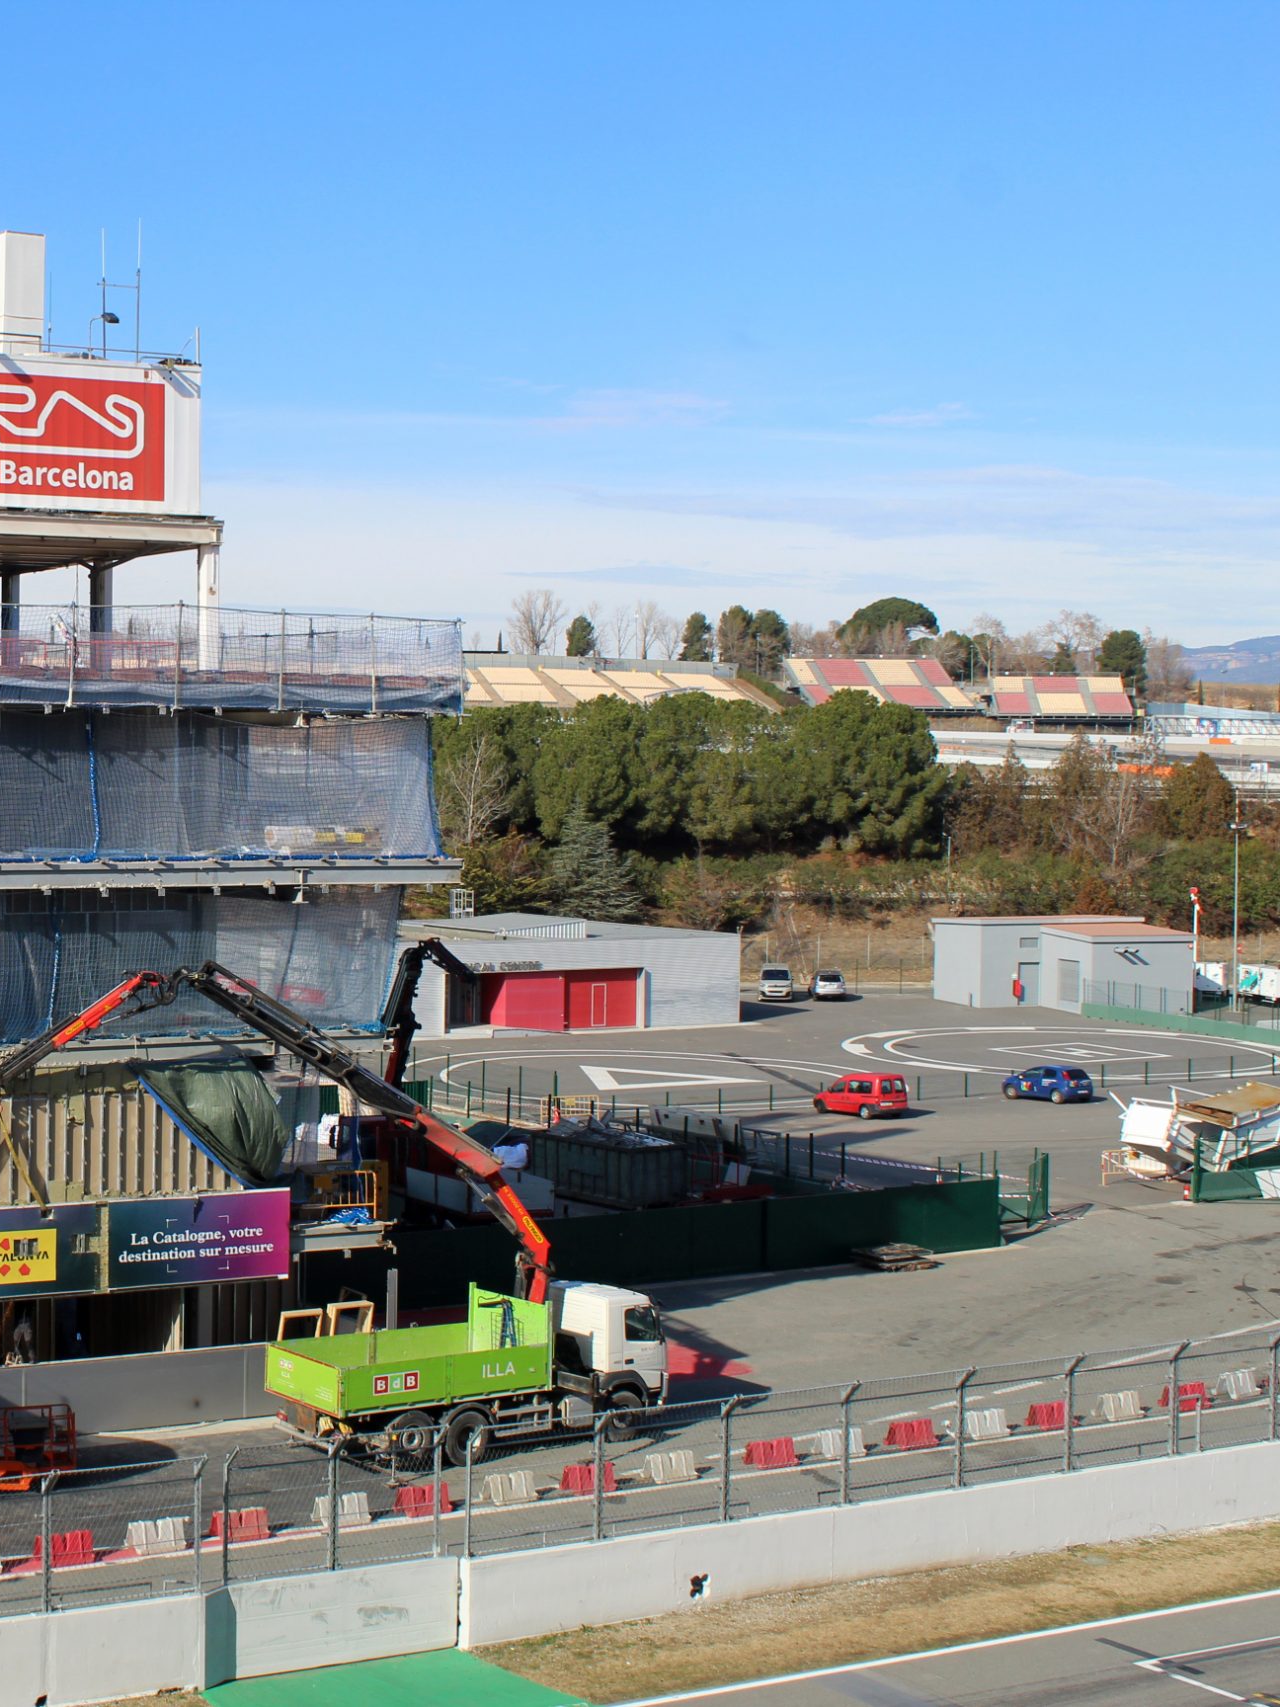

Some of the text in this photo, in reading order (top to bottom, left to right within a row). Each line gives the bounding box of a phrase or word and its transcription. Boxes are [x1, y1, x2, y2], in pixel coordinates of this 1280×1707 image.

[0, 459, 134, 491] Barcelona
[130, 1226, 264, 1246] La Catalogne, votre
[118, 1241, 275, 1264] destination sur mesure
[482, 1361, 516, 1378] ILLA
[376, 1374, 417, 1392] BdB
